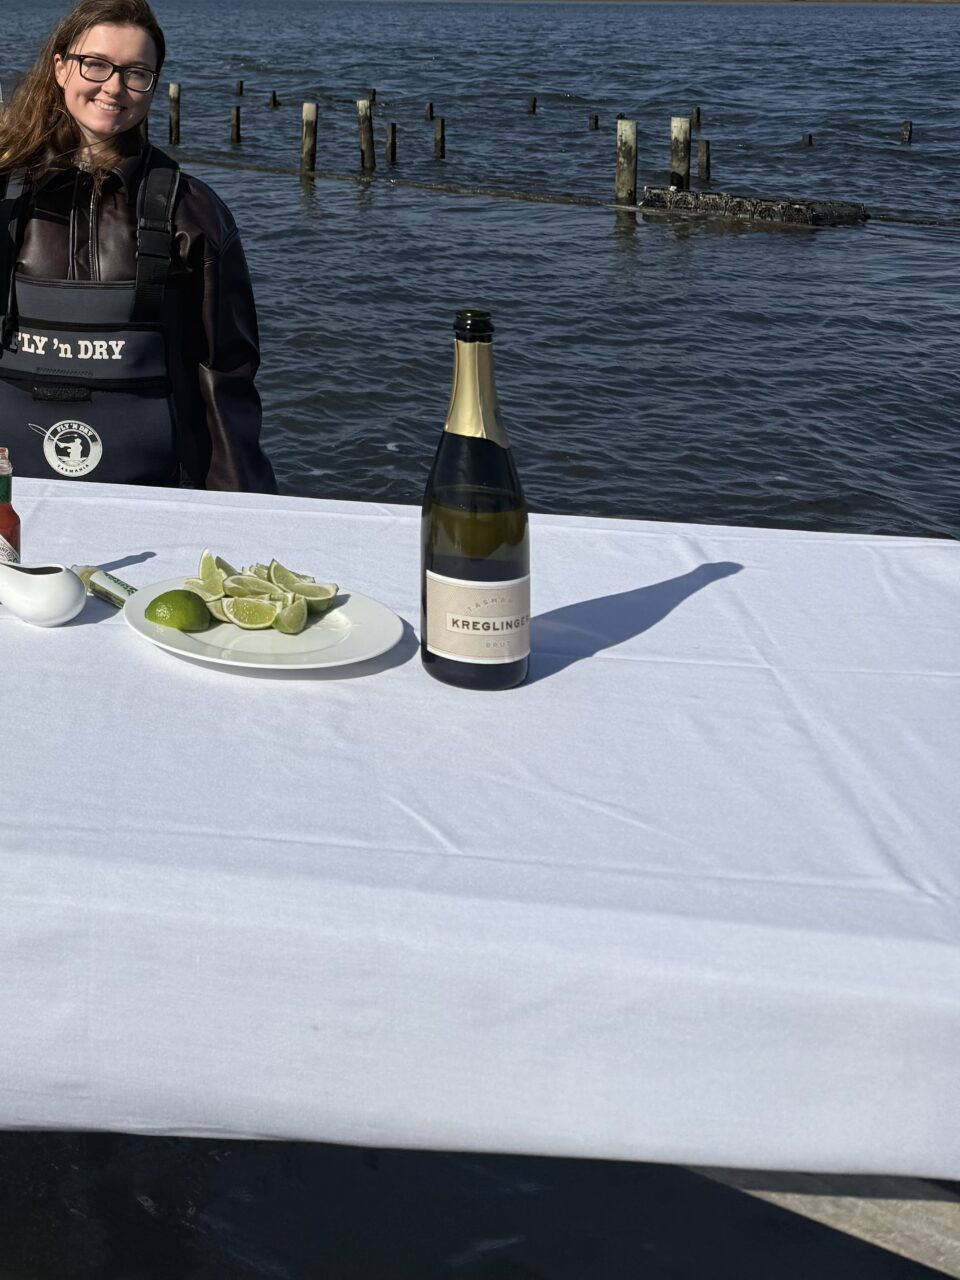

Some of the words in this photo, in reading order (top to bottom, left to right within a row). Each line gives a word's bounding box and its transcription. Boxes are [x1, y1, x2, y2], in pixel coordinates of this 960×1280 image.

[77, 340, 126, 360] DRY
[56, 423, 70, 433] FLY
[78, 425, 93, 437] DRY
[57, 464, 89, 473] TASMANIA
